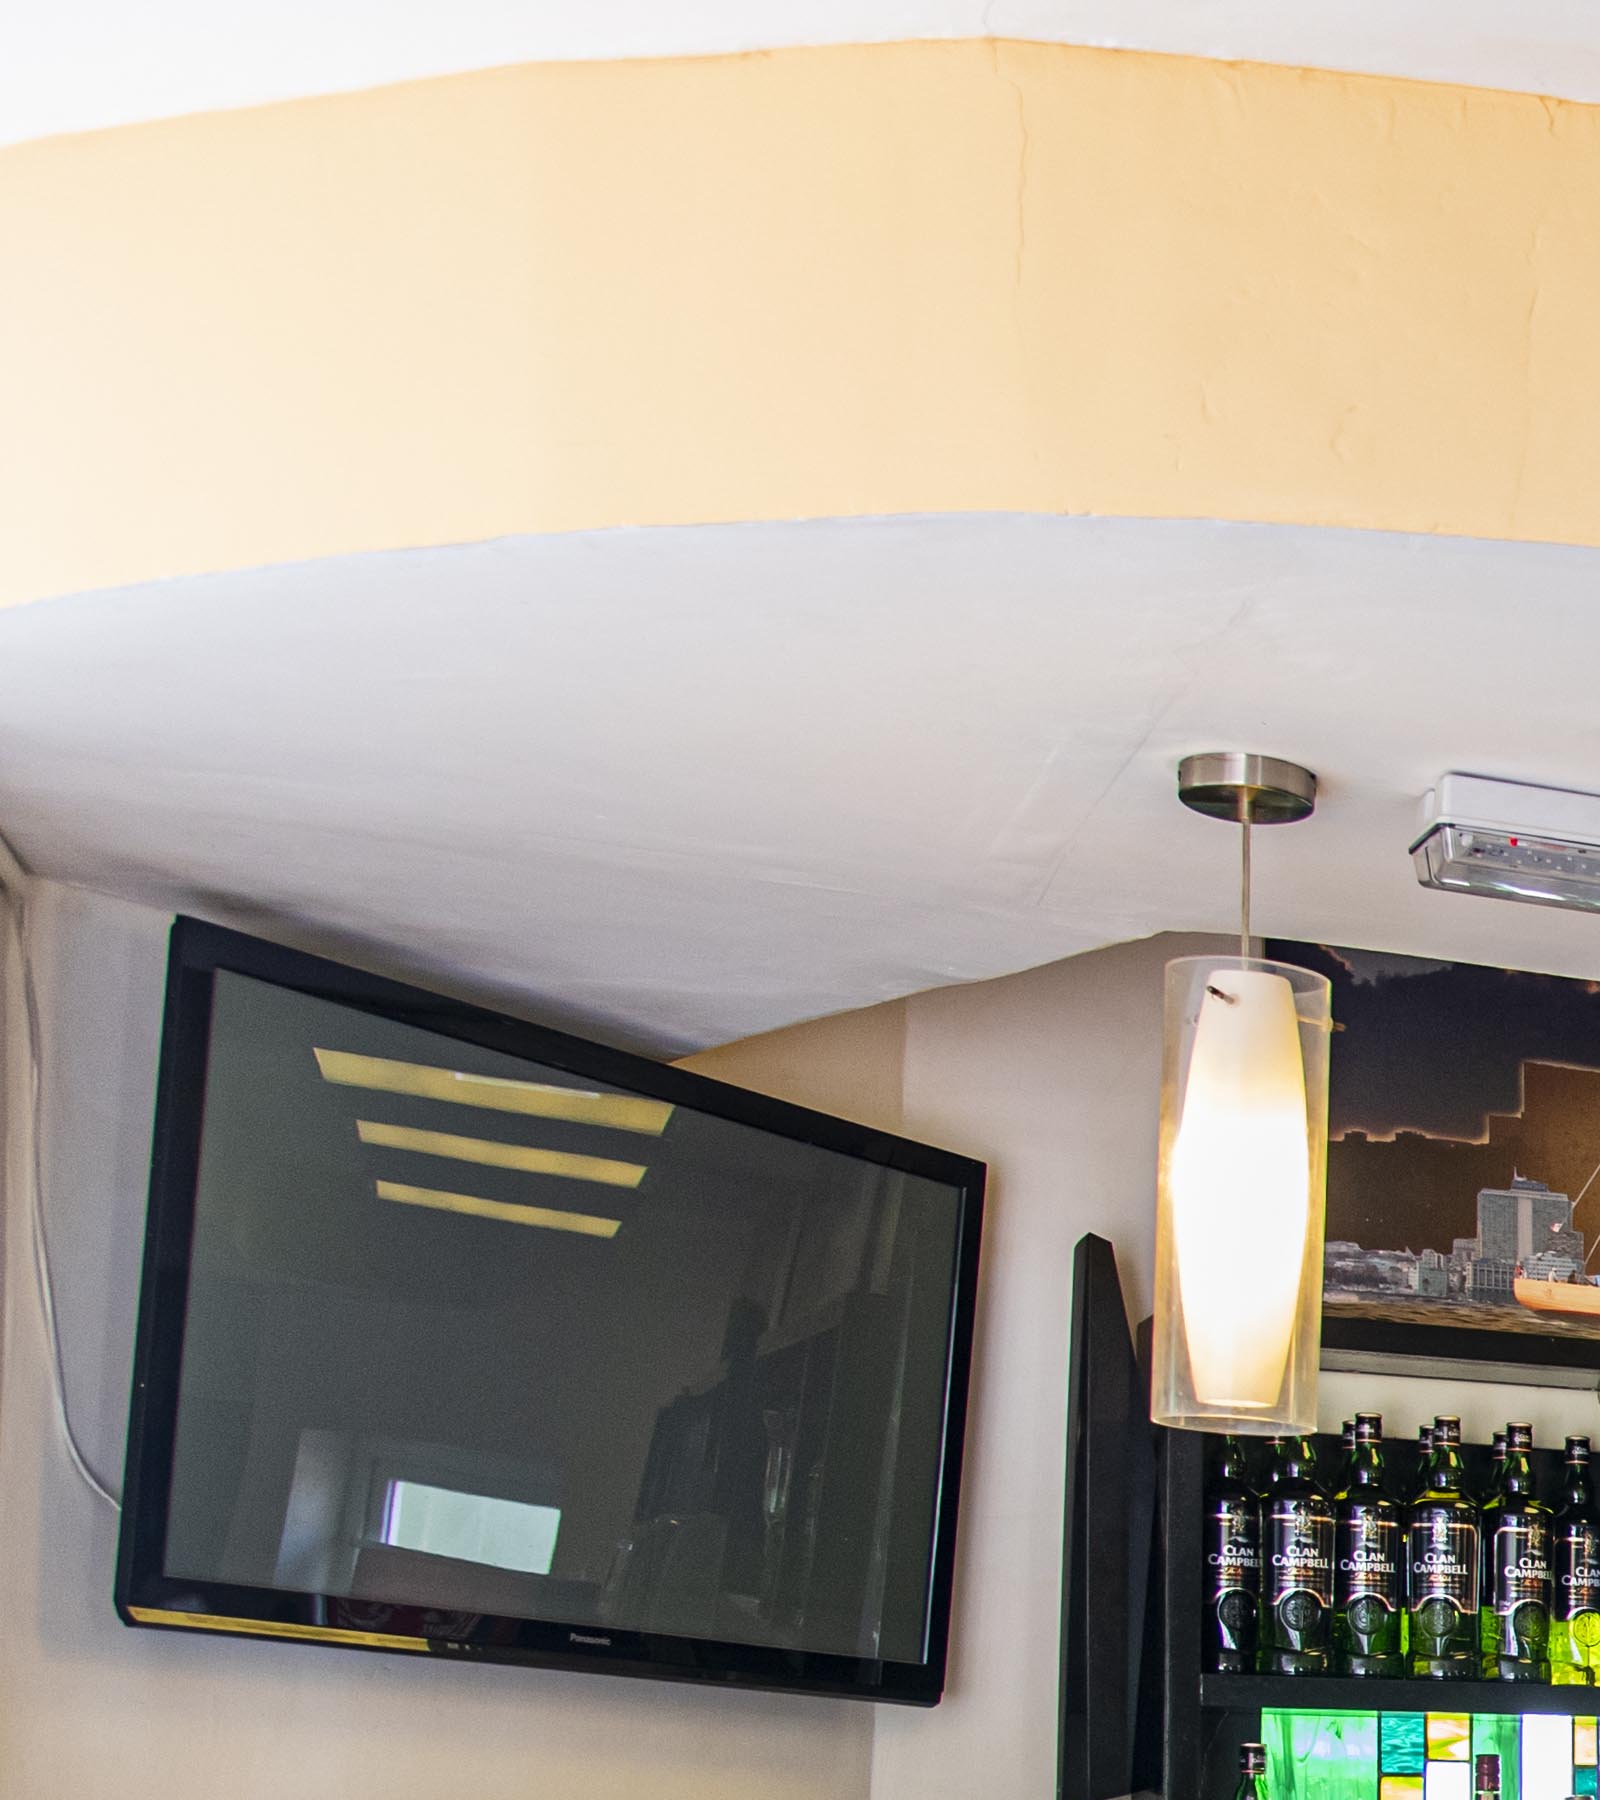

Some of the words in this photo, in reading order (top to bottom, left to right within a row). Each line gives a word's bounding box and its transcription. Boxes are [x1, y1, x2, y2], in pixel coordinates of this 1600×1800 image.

[1223, 1544, 1254, 1557] CLAN
[1286, 1545, 1319, 1557] CLAN
[1353, 1551, 1385, 1562] CLAN
[1272, 1554, 1329, 1568] CAMPBELL
[1424, 1553, 1456, 1564] CLAN
[1519, 1557, 1547, 1570] CLAN
[1340, 1559, 1396, 1573] CAMPBELL
[1413, 1562, 1468, 1575] CAMPBELL
